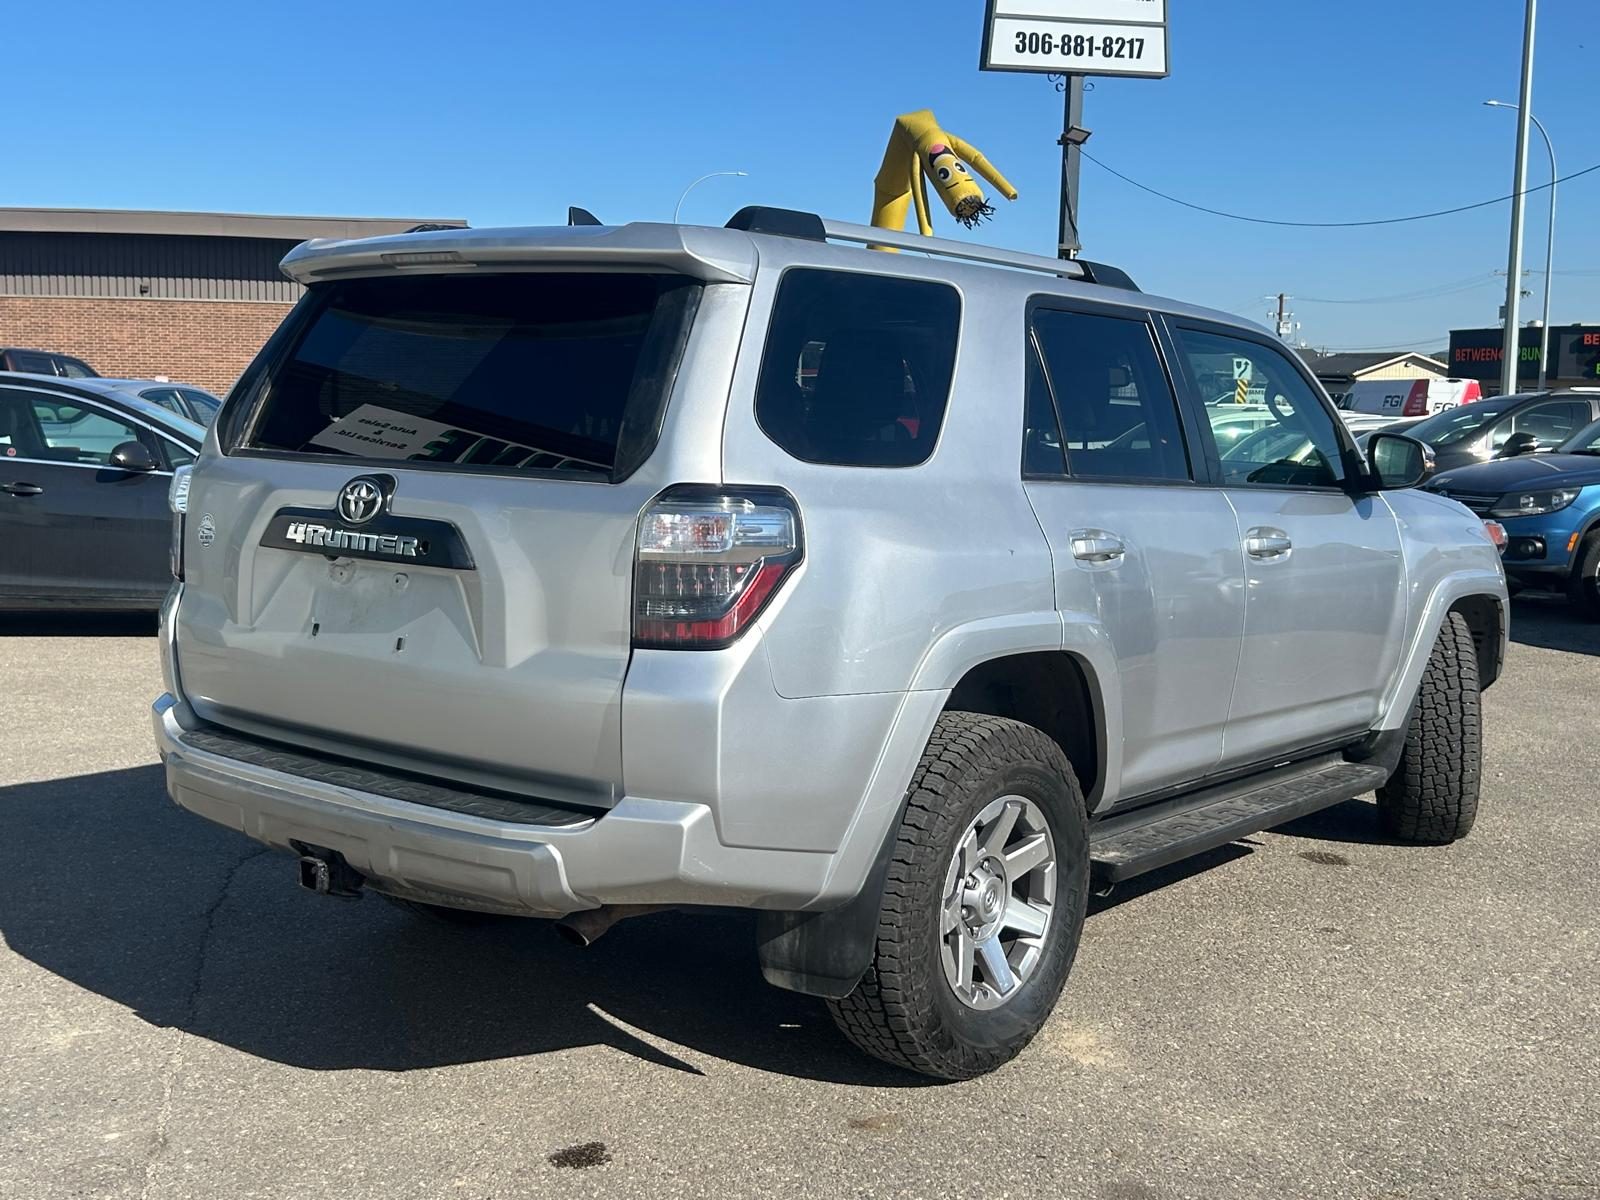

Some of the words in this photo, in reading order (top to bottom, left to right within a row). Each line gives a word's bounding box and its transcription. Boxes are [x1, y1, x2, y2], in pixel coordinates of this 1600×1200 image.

[1014, 31, 1145, 60] 306-881-8217
[1455, 348, 1498, 361] BETWEEN
[1521, 347, 1548, 361] BUN
[1382, 395, 1404, 408] FGI
[286, 521, 420, 558] 4RUNNER
